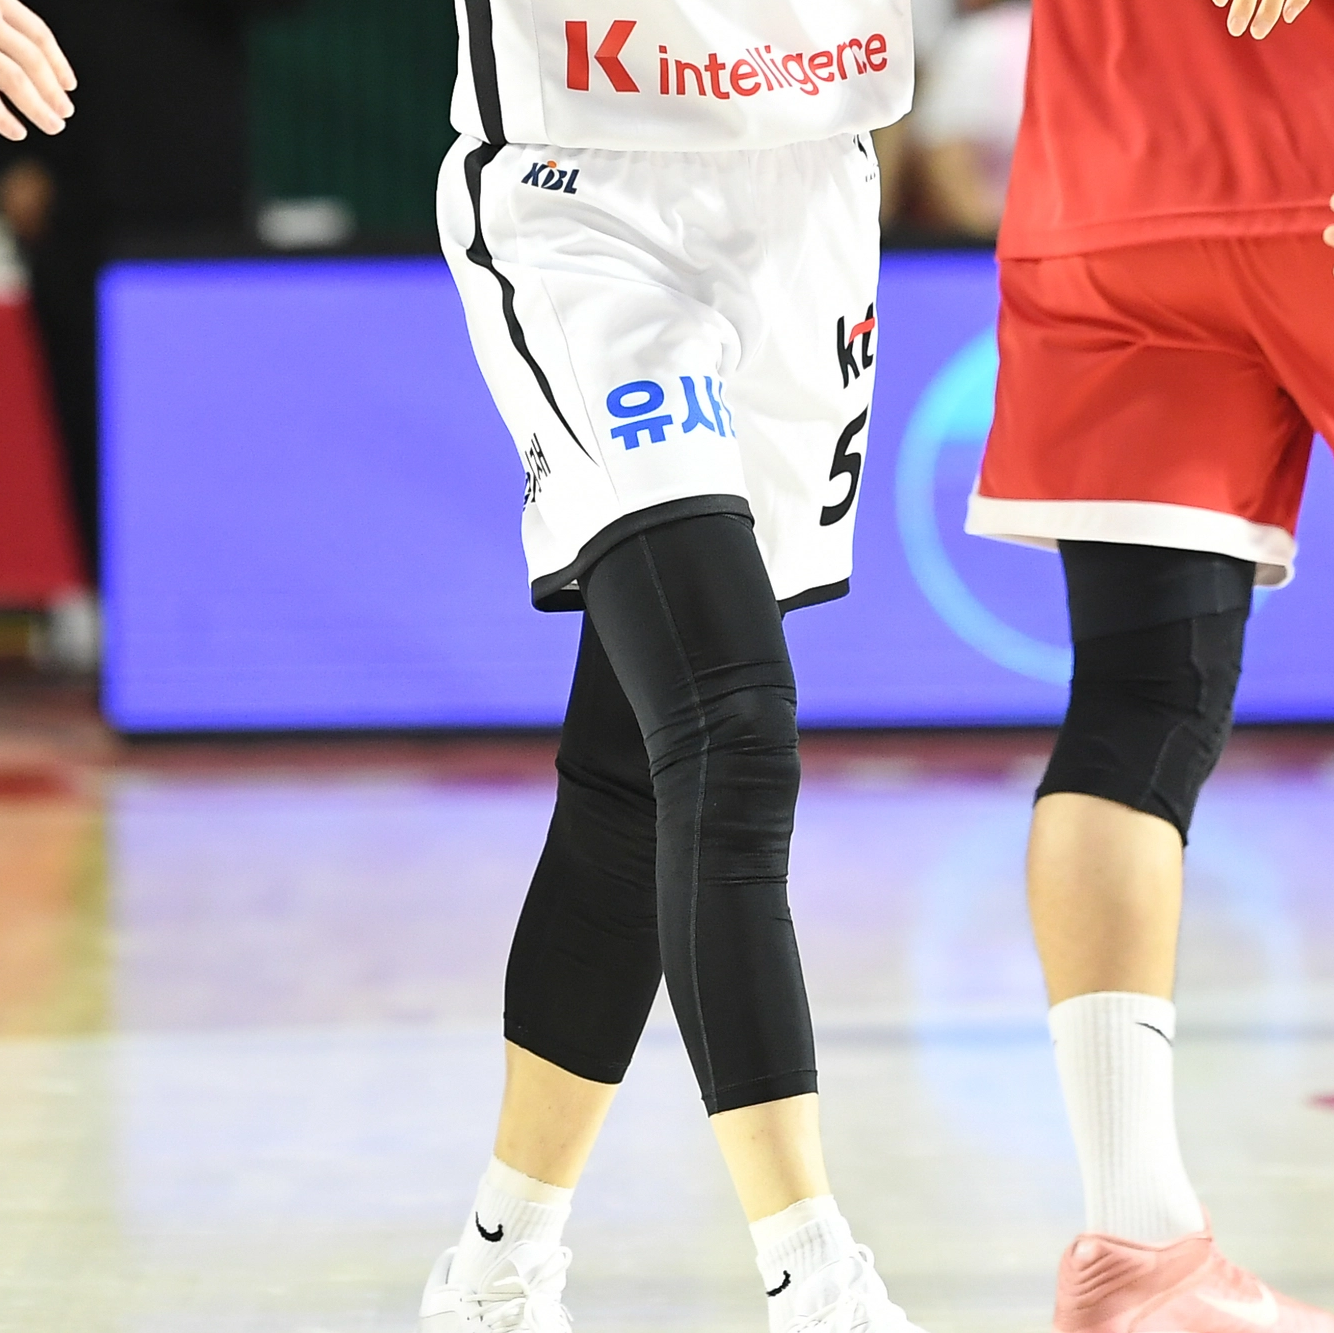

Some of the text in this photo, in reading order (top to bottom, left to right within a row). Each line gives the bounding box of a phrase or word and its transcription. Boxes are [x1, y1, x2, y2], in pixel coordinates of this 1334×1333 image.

[565, 20, 639, 93] K
[520, 160, 580, 195] KBL
[837, 302, 876, 389] kt
[605, 374, 738, 450] 유사
[819, 404, 869, 526] 5
